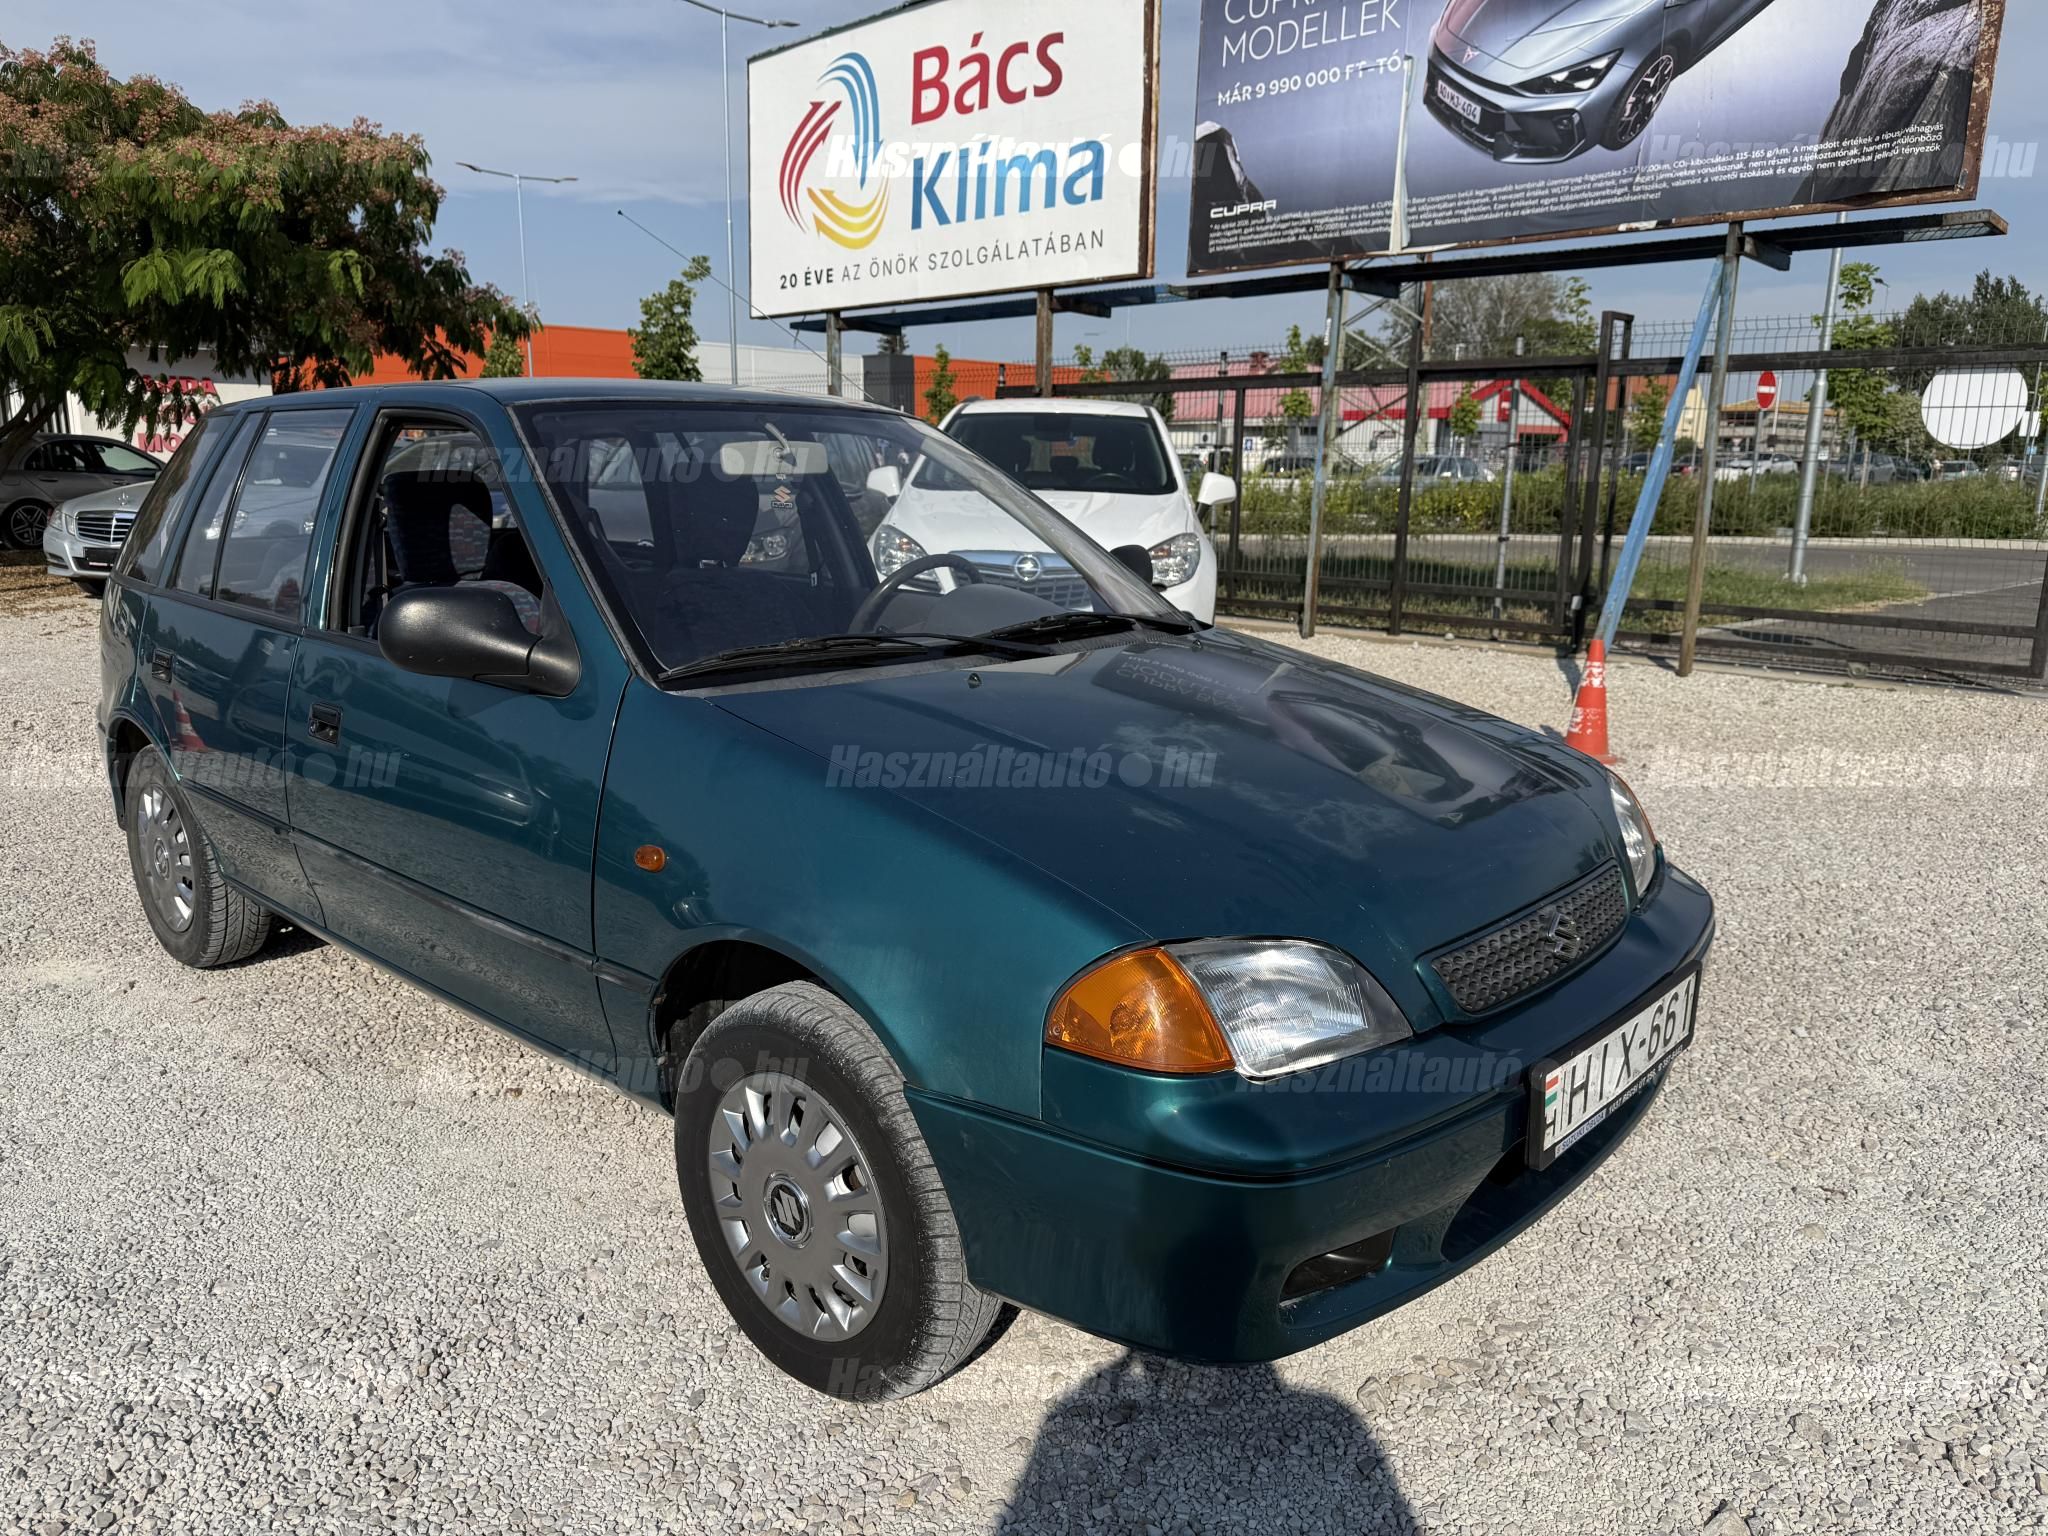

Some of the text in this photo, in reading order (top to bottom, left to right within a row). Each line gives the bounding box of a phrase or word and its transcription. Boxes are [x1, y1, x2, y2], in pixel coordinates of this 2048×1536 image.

[1222, 0, 1401, 68] MODELLEK
[911, 31, 1064, 126] Bács
[1217, 82, 1251, 106] MÁR
[1255, 83, 1265, 98] 9
[1269, 75, 1301, 96] 990
[1305, 67, 1341, 88] 000
[1800, 139, 1840, 153] megadott
[1842, 135, 1872, 146] értékek
[910, 139, 1106, 231] Klíma
[1210, 199, 1277, 219] CUPRA
[780, 229, 1104, 289] 20 ÉVE AZ ÖNÖK SZOLGÁLATÁBAN
[1567, 977, 1693, 1126] HIX-661
